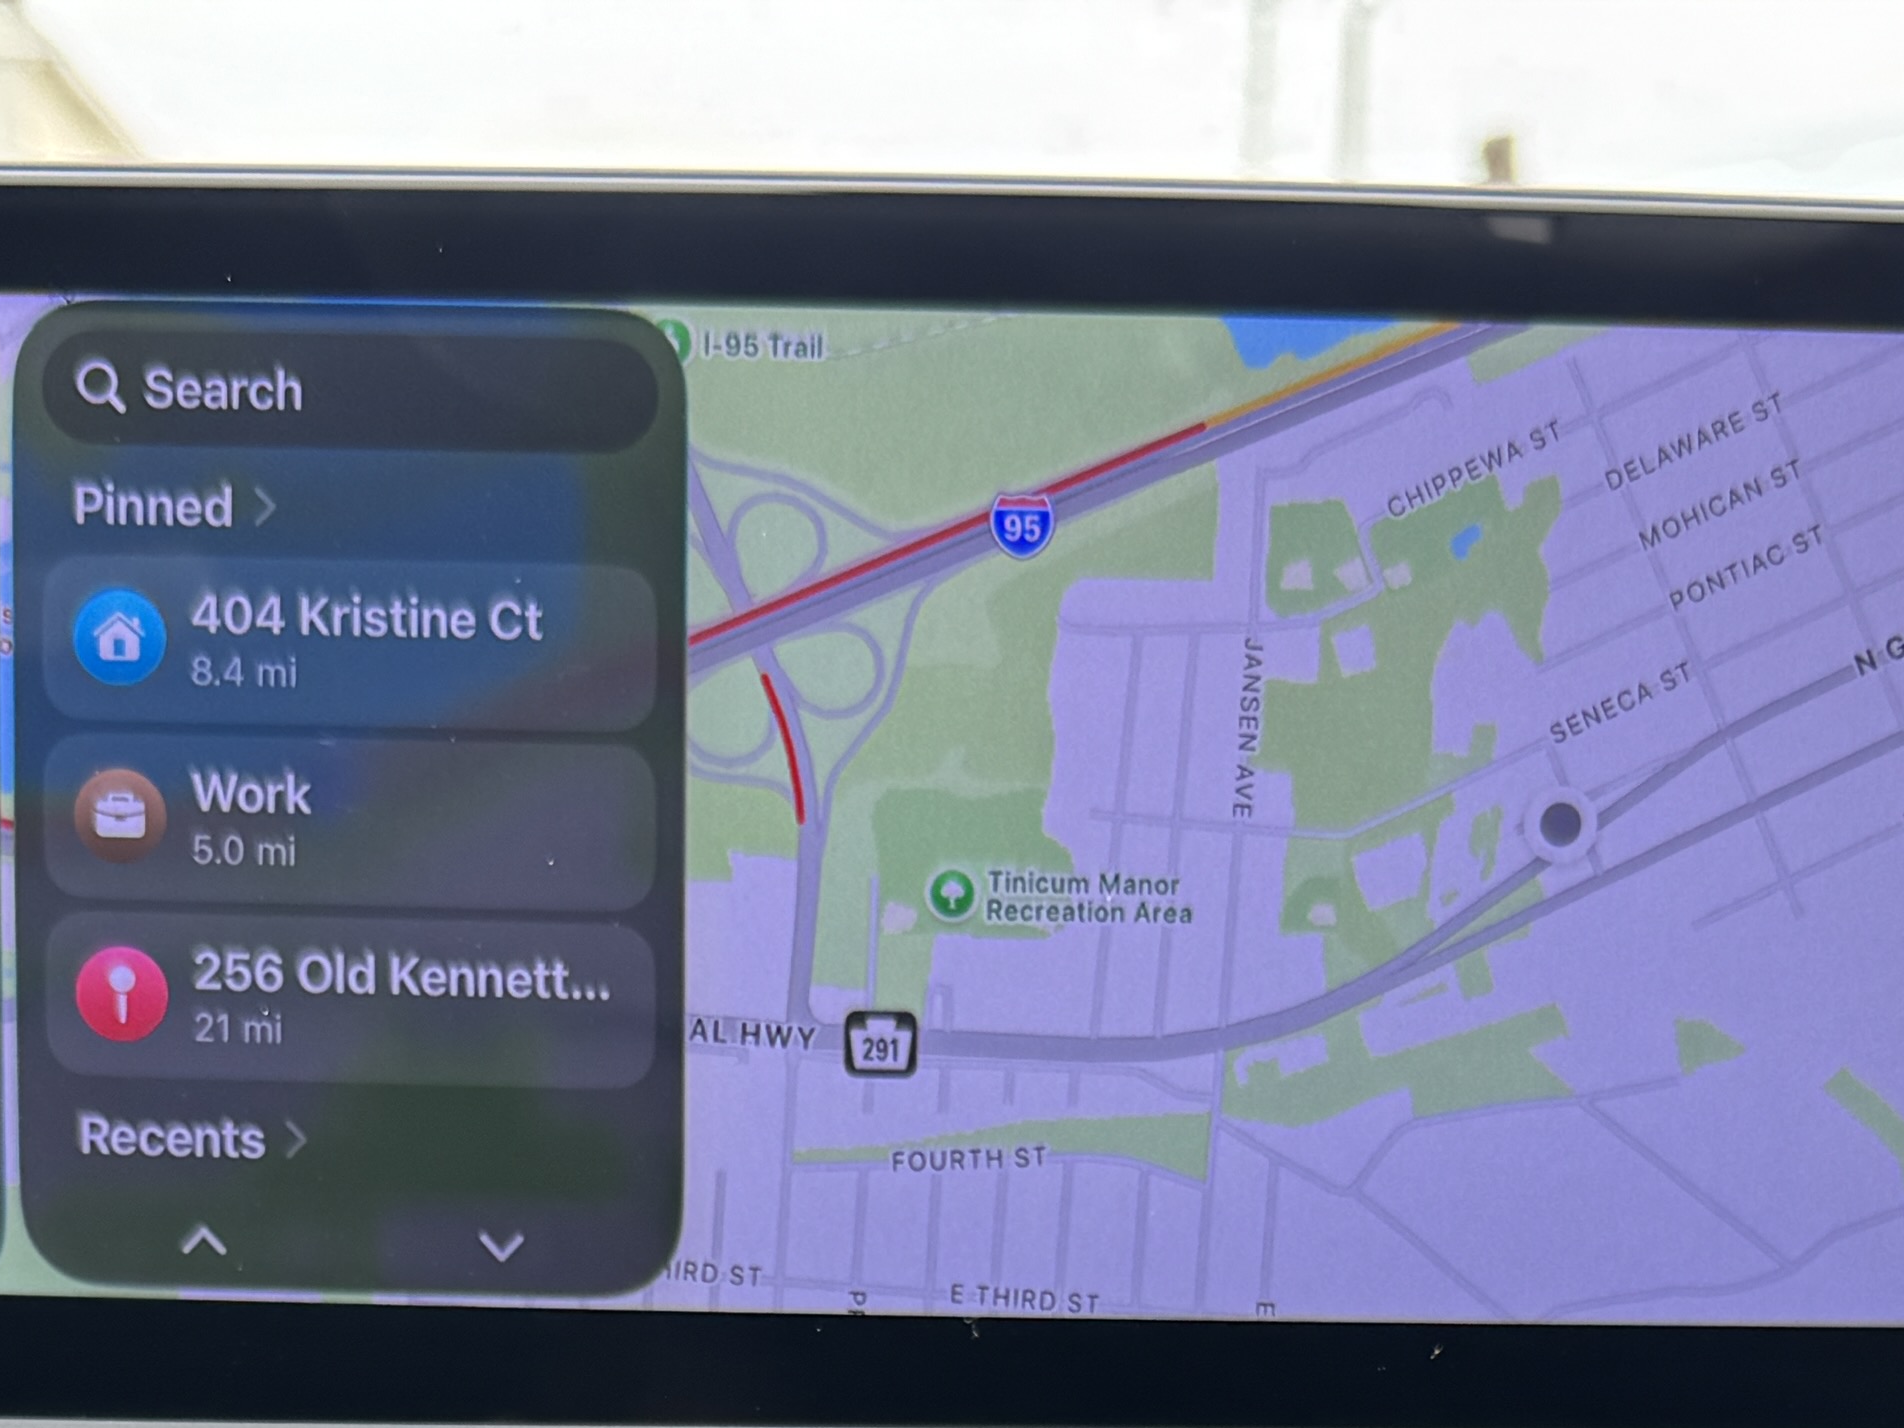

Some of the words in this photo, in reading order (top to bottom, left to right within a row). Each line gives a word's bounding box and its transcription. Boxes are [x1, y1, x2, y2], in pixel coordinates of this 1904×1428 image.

[702, 333, 760, 358] I-95
[766, 333, 824, 360] Trail
[143, 368, 303, 412] Search
[1604, 409, 1748, 492] DELAWARE
[1752, 392, 1785, 422] ST
[1387, 440, 1524, 518] CHIPPEWA
[1529, 420, 1563, 452] ST
[74, 485, 234, 529] Pinned
[1639, 476, 1763, 552] MOHICAN
[1769, 458, 1804, 489] ST
[1003, 515, 1041, 542] 95
[1669, 543, 1787, 612] PONTIAC
[1792, 524, 1824, 555] ST
[191, 595, 286, 636] 404
[300, 597, 476, 642] Kristine
[487, 600, 544, 643] Ct
[190, 656, 246, 689] 8.4
[257, 657, 298, 688] mi
[1853, 647, 1879, 677] N
[1238, 635, 1264, 753] JANSEN
[1549, 681, 1656, 746] SENECA
[1660, 661, 1694, 693] ST
[191, 772, 312, 817] Work
[1232, 765, 1255, 820] AVE
[192, 835, 245, 866] 5.0
[257, 836, 297, 867] mi
[988, 870, 1090, 895] Tinicum
[1098, 873, 1180, 897] Manor
[987, 900, 1125, 924] Recreation
[1134, 902, 1193, 925] Area
[193, 951, 284, 993] 256
[297, 953, 376, 997] Old
[390, 956, 611, 1001] Kennett...
[194, 1012, 236, 1044] 21
[245, 1014, 284, 1046] mi
[741, 1025, 817, 1050] HWY
[862, 1037, 900, 1063] 291
[78, 1112, 266, 1160] Recents
[892, 1147, 1004, 1172] FOURTH
[1014, 1146, 1048, 1169] ST
[730, 1264, 762, 1288] ST
[950, 1285, 964, 1304] E
[978, 1285, 1057, 1314] THIRD
[1067, 1291, 1101, 1315] ST
